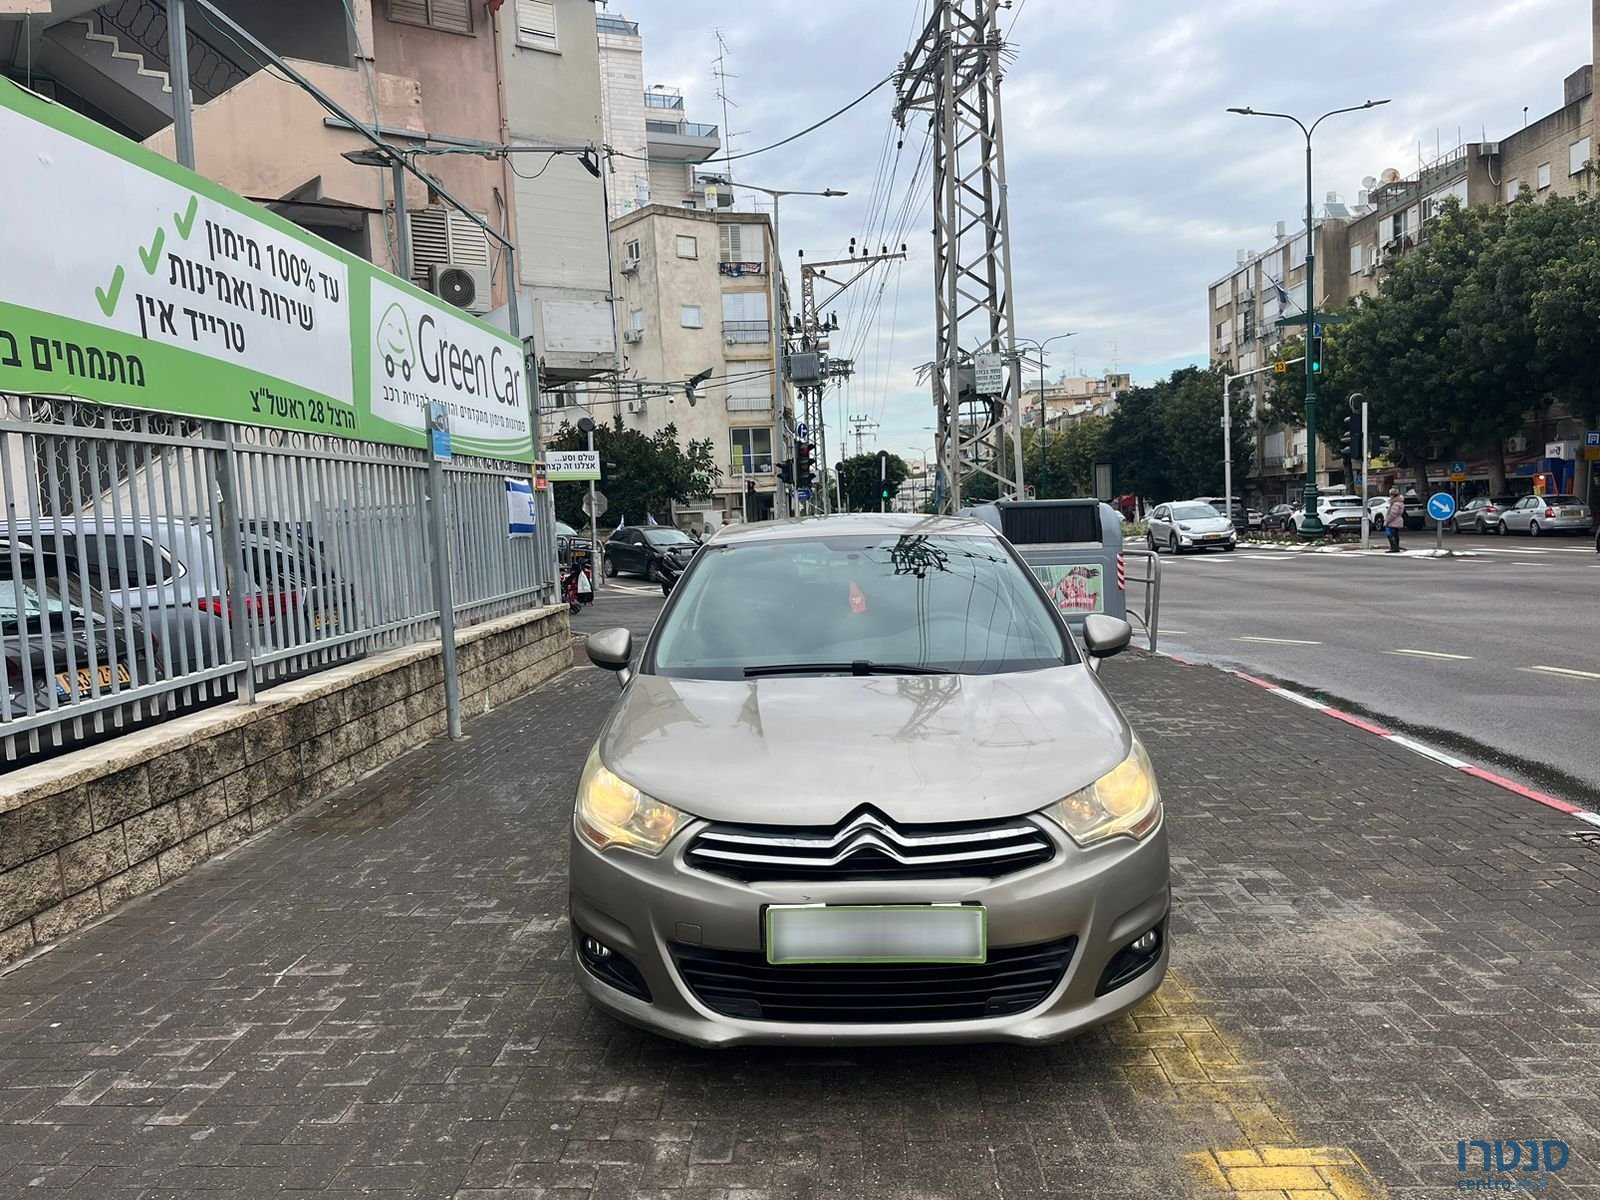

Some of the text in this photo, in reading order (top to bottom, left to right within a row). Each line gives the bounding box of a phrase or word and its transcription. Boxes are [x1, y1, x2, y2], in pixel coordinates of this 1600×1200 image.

[205, 218, 339, 304] עד 100% מימון
[168, 253, 314, 332] שירות ואמינות
[135, 293, 246, 354] טרייד אין
[30, 335, 145, 387] מתמחים
[418, 314, 520, 407] Green Car
[1276, 362, 1285, 371] 13
[383, 385, 400, 404] רכב
[308, 399, 325, 424] 28
[326, 401, 356, 430] הרצל
[563, 462, 573, 470] זה
[574, 462, 596, 470] אצלנו
[578, 453, 595, 462] שלם
